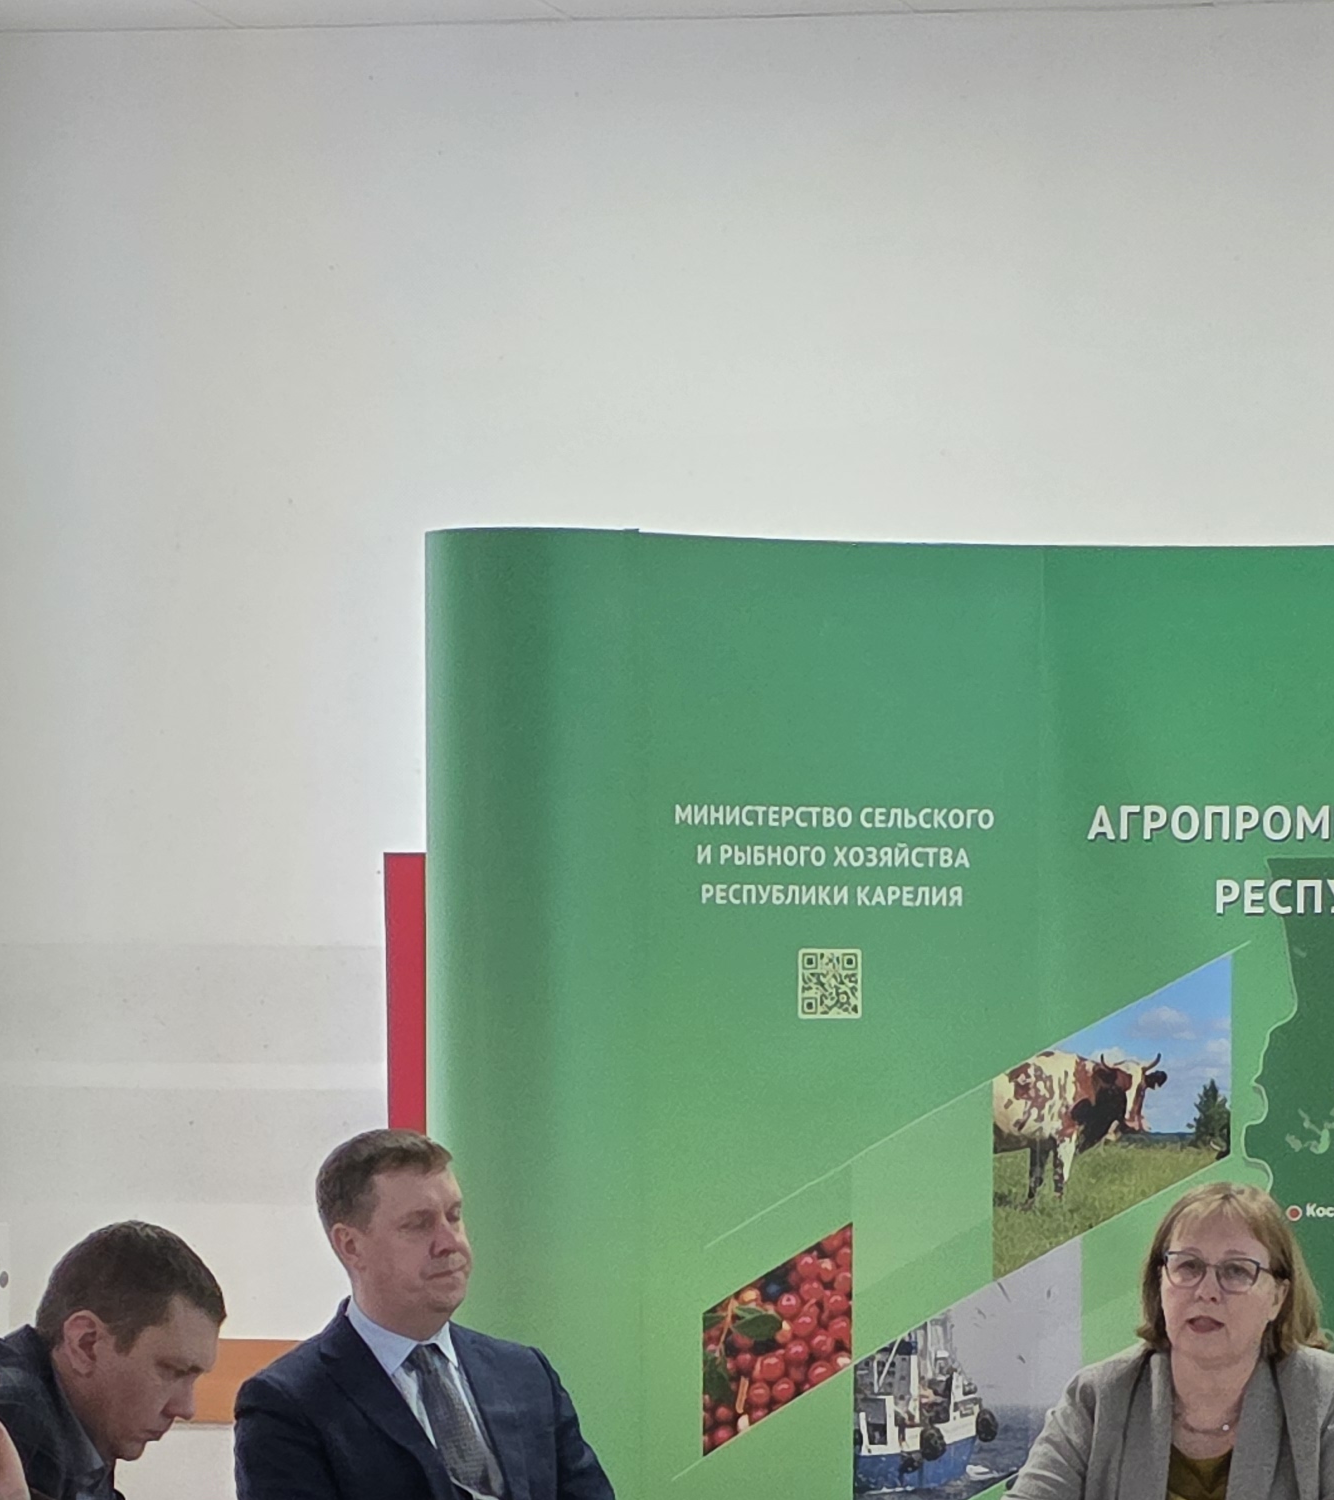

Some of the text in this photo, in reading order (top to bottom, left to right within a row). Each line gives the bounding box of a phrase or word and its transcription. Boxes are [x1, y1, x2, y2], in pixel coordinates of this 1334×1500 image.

[674, 804, 995, 830] МИНИСТЕРСТВО СЕЛЬСКОГО
[696, 841, 971, 869] И РЫБНОГО ХОЗЯЙСТВА
[701, 883, 964, 908] РЕСПУБЛИКИ КАРЕЛИЯ
